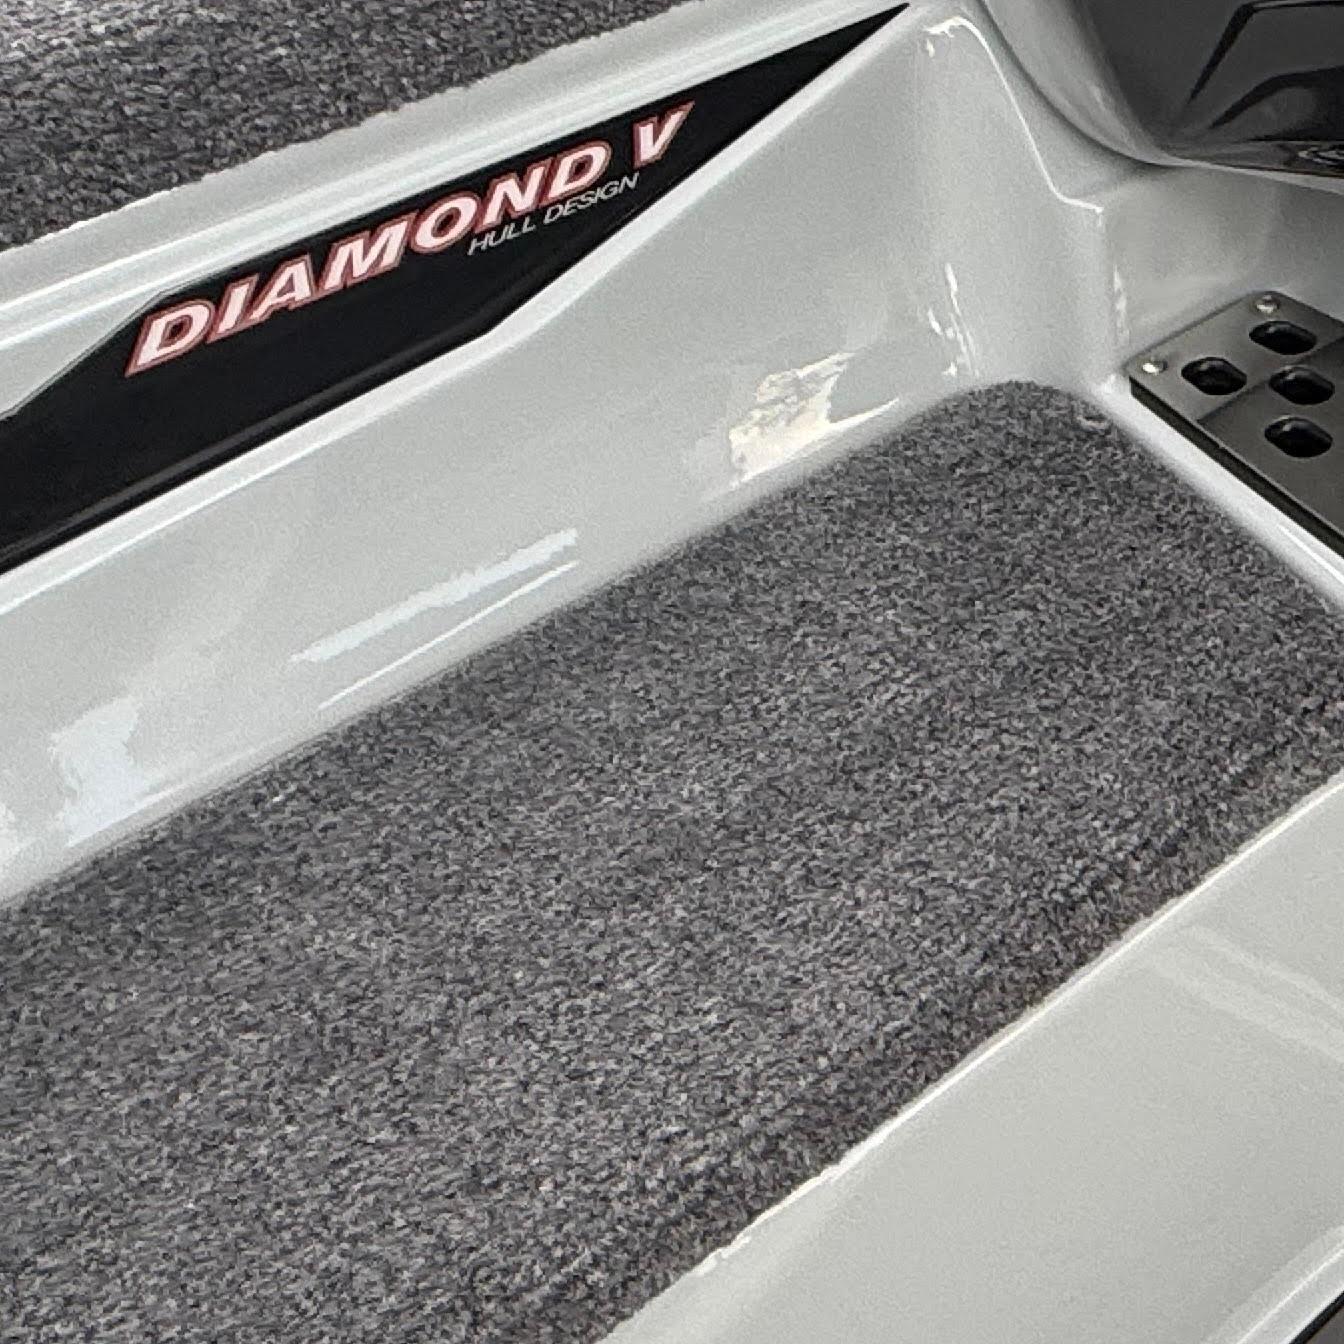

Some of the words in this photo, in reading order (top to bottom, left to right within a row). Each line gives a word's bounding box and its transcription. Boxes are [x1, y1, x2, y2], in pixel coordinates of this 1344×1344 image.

[124, 141, 613, 377] DIAMOND
[632, 100, 696, 167] V
[468, 215, 536, 256] HULL
[542, 173, 640, 224] DESIGN
